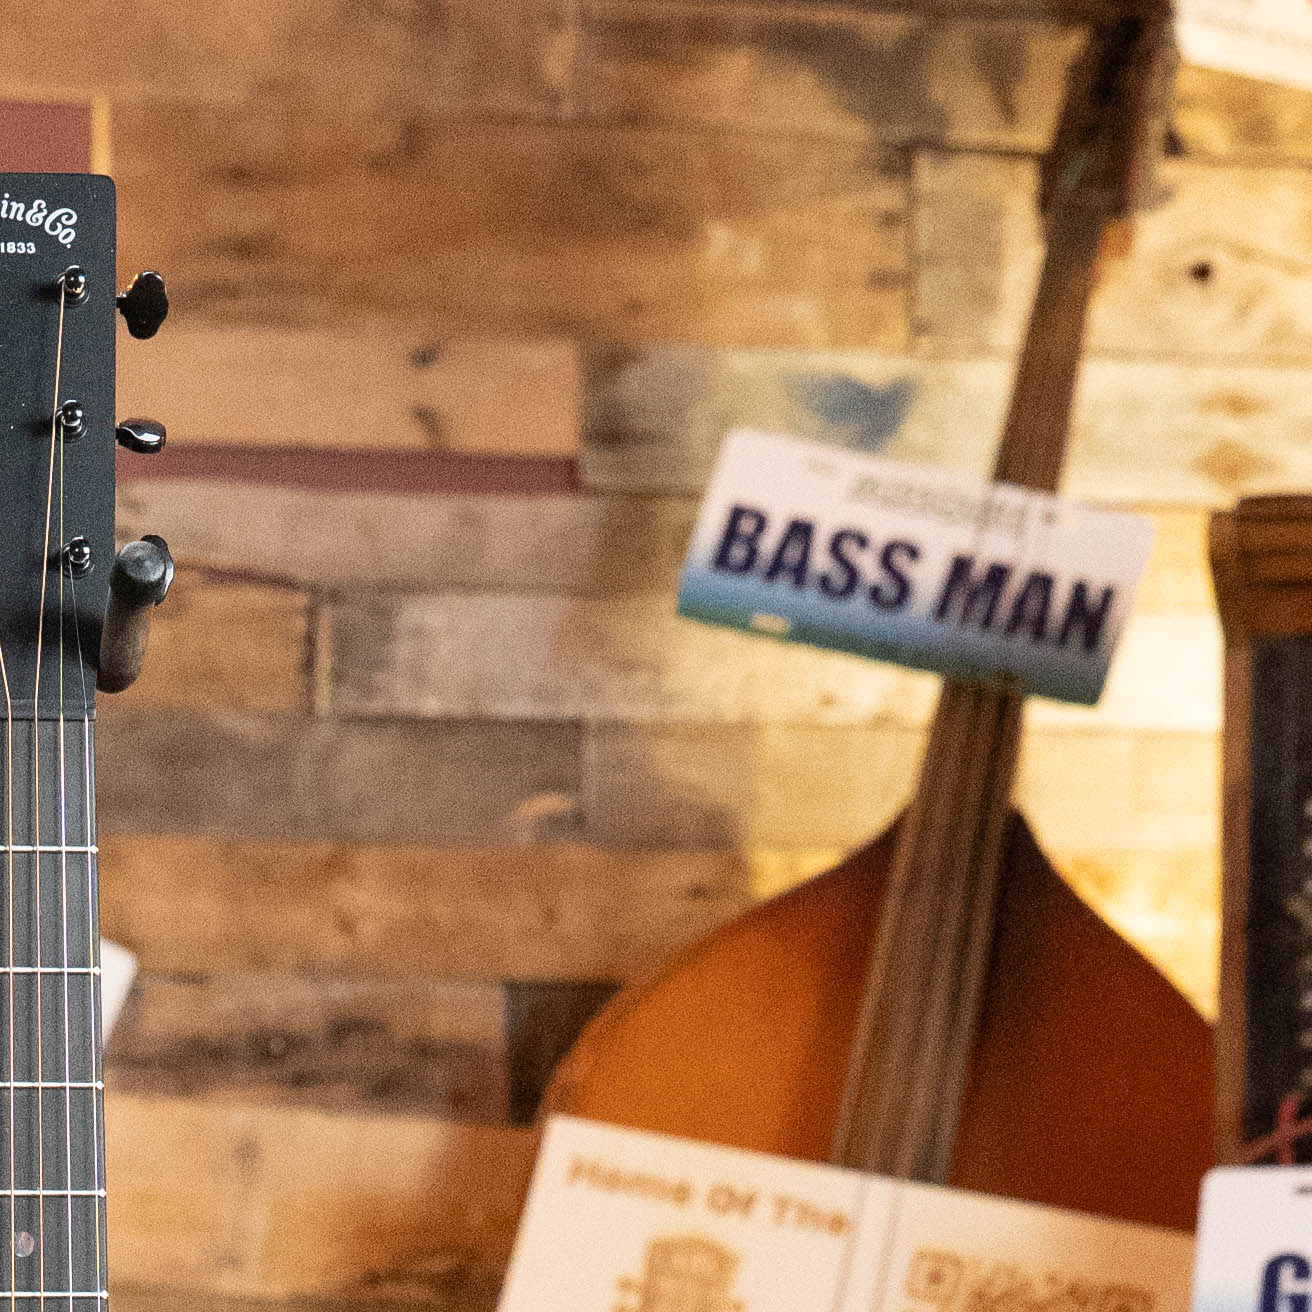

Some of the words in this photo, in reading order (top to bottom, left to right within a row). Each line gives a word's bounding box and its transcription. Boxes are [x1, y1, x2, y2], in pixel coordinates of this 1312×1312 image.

[0, 241, 36, 254] 1833
[712, 504, 920, 611] BASS
[934, 553, 1115, 650] MAN
[773, 1194, 852, 1237] The
